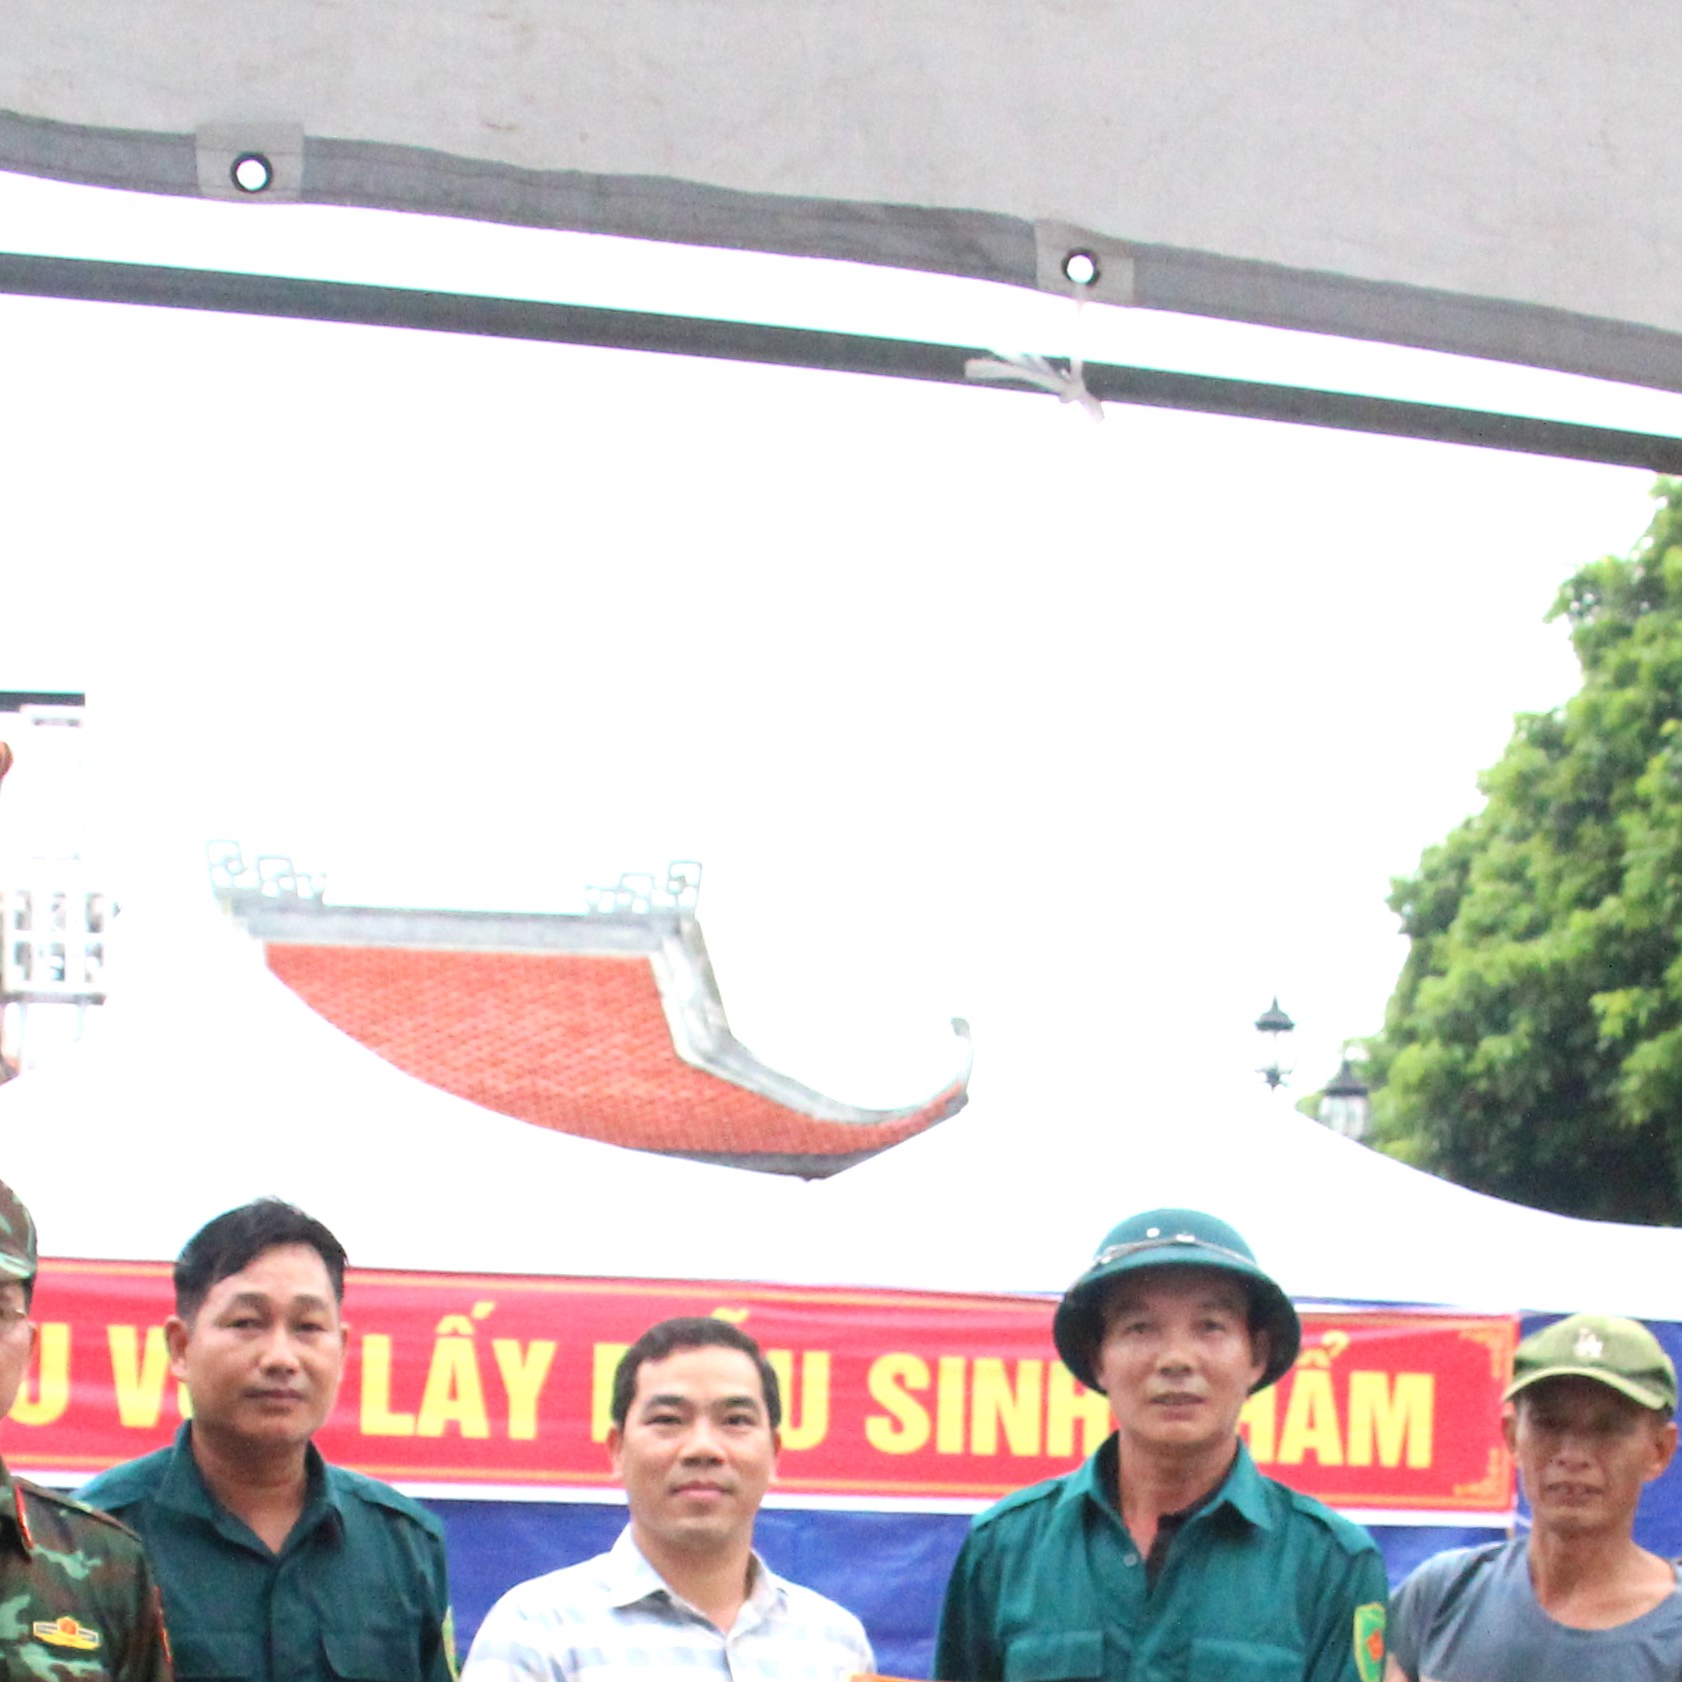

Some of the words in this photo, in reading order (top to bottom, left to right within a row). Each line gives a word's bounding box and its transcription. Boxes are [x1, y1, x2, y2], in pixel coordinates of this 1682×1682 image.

[359, 1301, 556, 1440] LẤY
[864, 1352, 1111, 1458] SINH
[1235, 1331, 1434, 1469] ẨM
